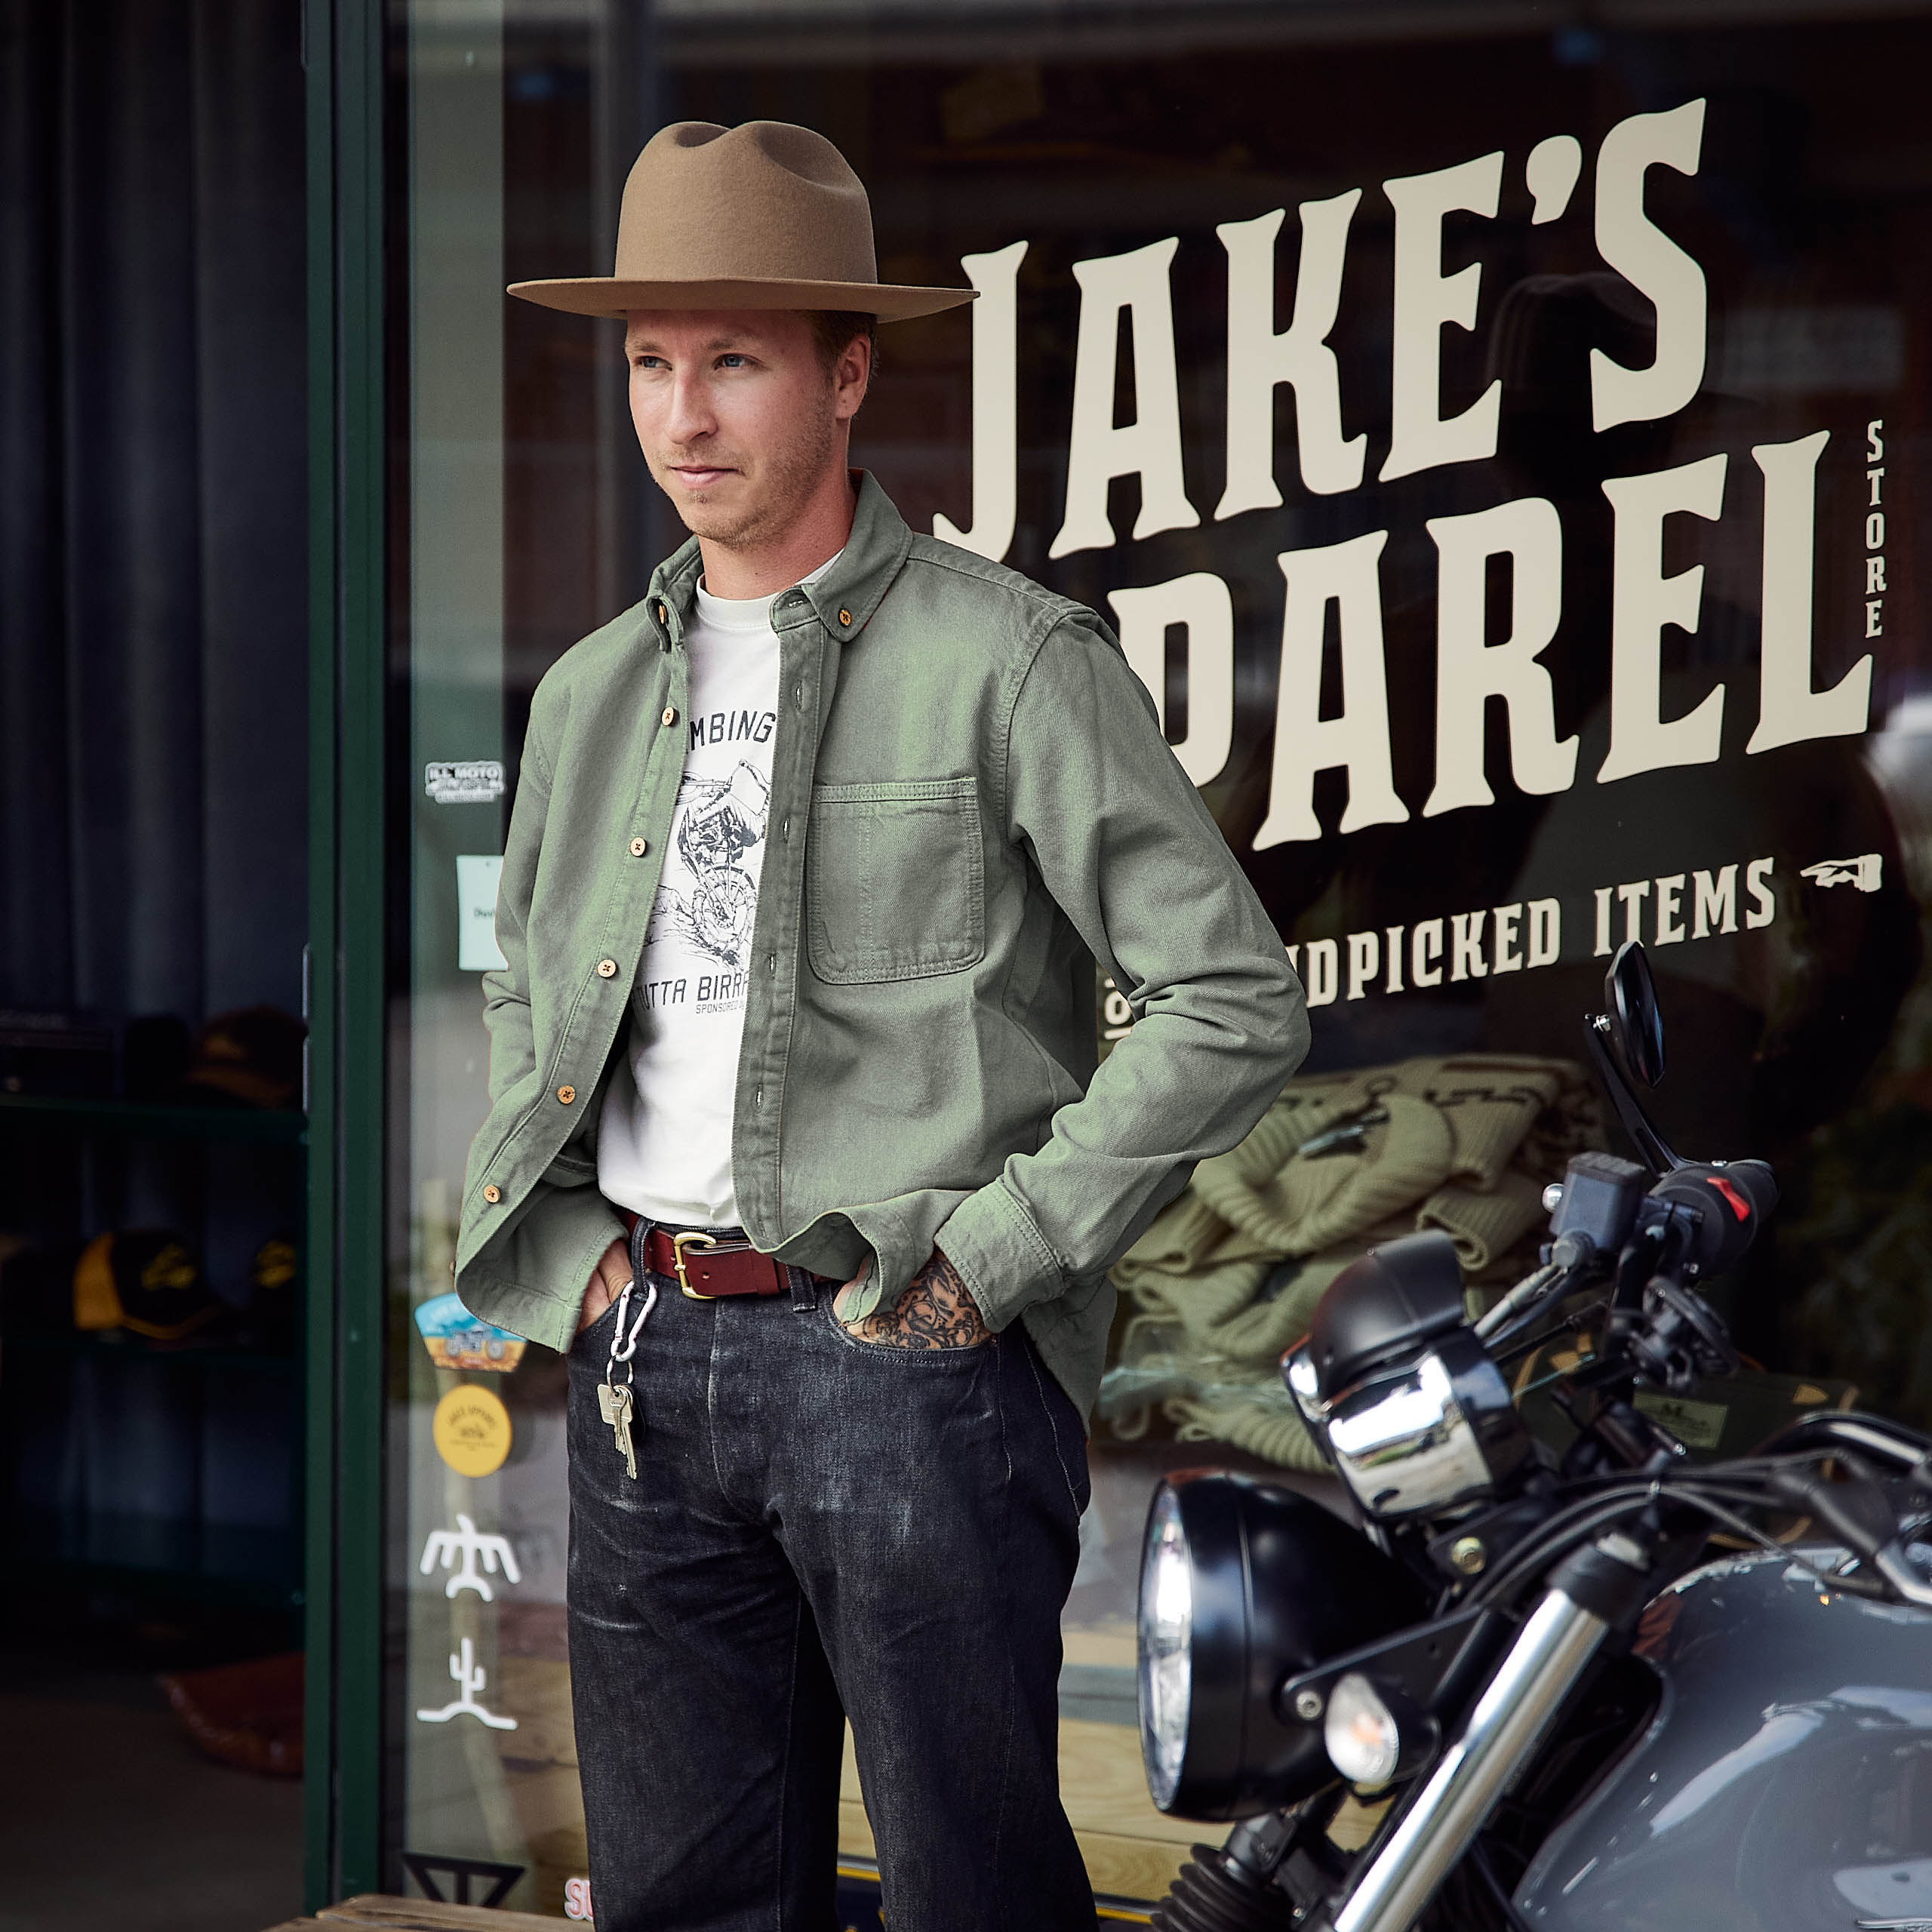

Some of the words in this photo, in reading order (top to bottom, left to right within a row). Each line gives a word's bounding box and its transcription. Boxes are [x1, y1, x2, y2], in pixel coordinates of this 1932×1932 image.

[932, 97, 1707, 565] JAKE'S
[1865, 420, 1887, 638] STORE
[688, 710, 777, 751] MBING
[1107, 430, 1873, 851] PAREL
[1593, 857, 1774, 957] ITEMS
